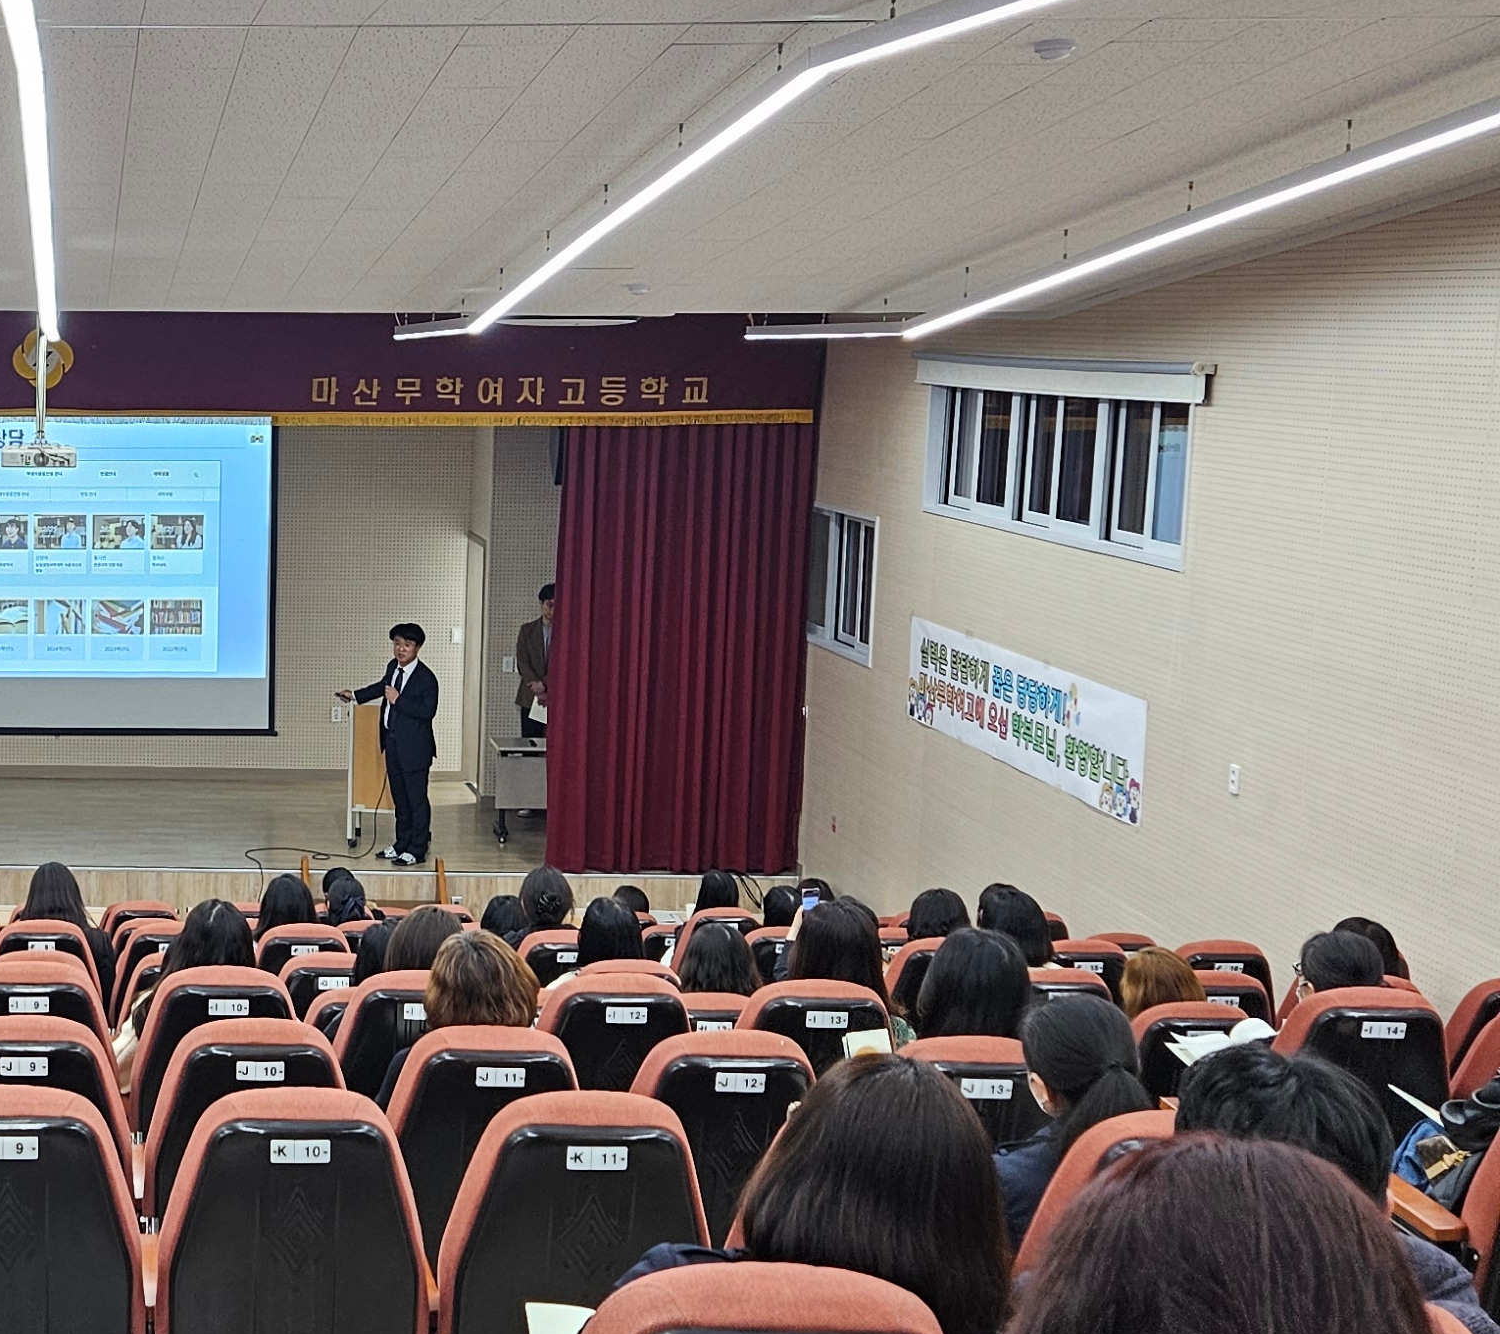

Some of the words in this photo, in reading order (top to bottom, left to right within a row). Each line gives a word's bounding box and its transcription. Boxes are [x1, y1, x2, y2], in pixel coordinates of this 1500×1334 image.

[311, 375, 709, 406] 마산무학여자고등학교
[920, 637, 948, 676] 실력은
[992, 664, 1014, 703] 꿈은
[33, 1000, 40, 1010] 9
[231, 1003, 243, 1012] 10
[629, 1011, 641, 1020] 12
[830, 1015, 842, 1025] 13
[1386, 1026, 1399, 1035] 14
[5, 1061, 13, 1072] J
[29, 1061, 36, 1072] 9
[241, 1065, 249, 1076] J
[263, 1066, 277, 1077] 10
[480, 1072, 489, 1082] J
[504, 1073, 517, 1083] 11
[719, 1077, 729, 1088] J
[744, 1078, 758, 1089] 12
[965, 1084, 975, 1095] J
[990, 1085, 1004, 1095] 13
[15, 1142, 24, 1155] 9
[277, 1145, 287, 1157] K
[304, 1146, 321, 1158] 10
[573, 1152, 584, 1164] K
[601, 1153, 617, 1165] 11
